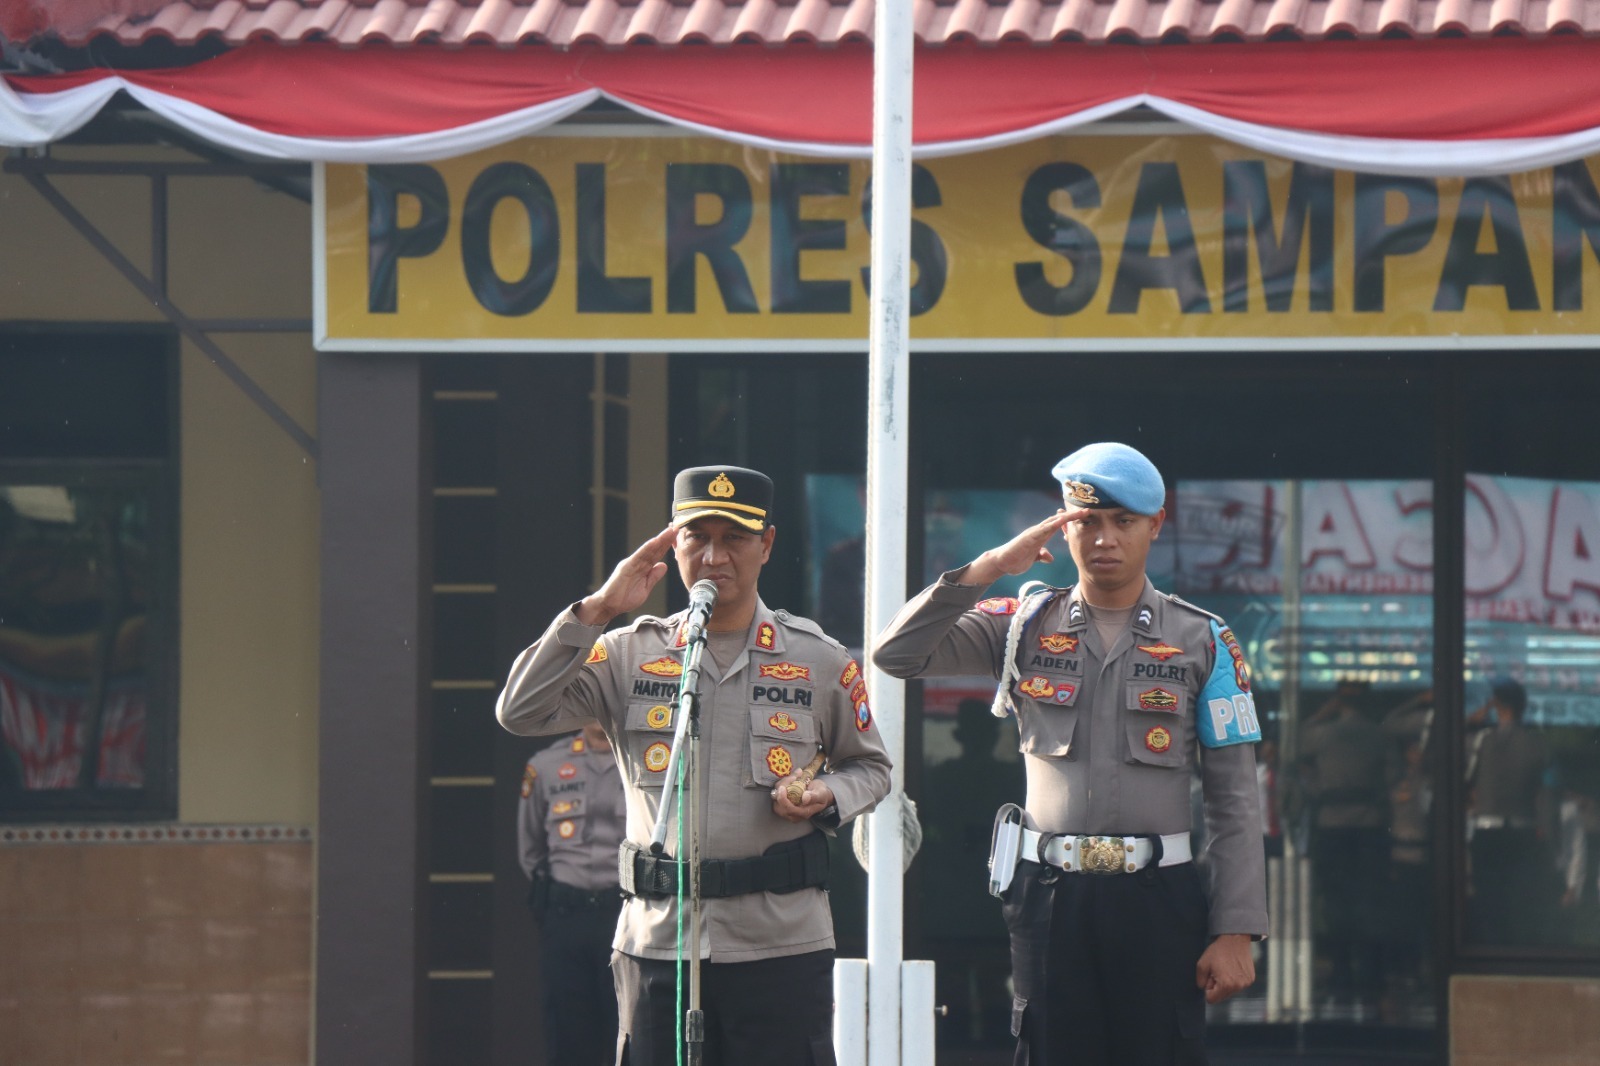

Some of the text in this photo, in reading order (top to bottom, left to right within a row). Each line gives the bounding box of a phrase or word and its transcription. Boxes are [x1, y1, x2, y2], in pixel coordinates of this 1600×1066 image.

[366, 161, 948, 318] POLRES
[1031, 654, 1078, 672] ADEN
[1133, 663, 1187, 682] POLRI
[753, 685, 813, 707] POLRI
[549, 781, 586, 796] SLAMET
